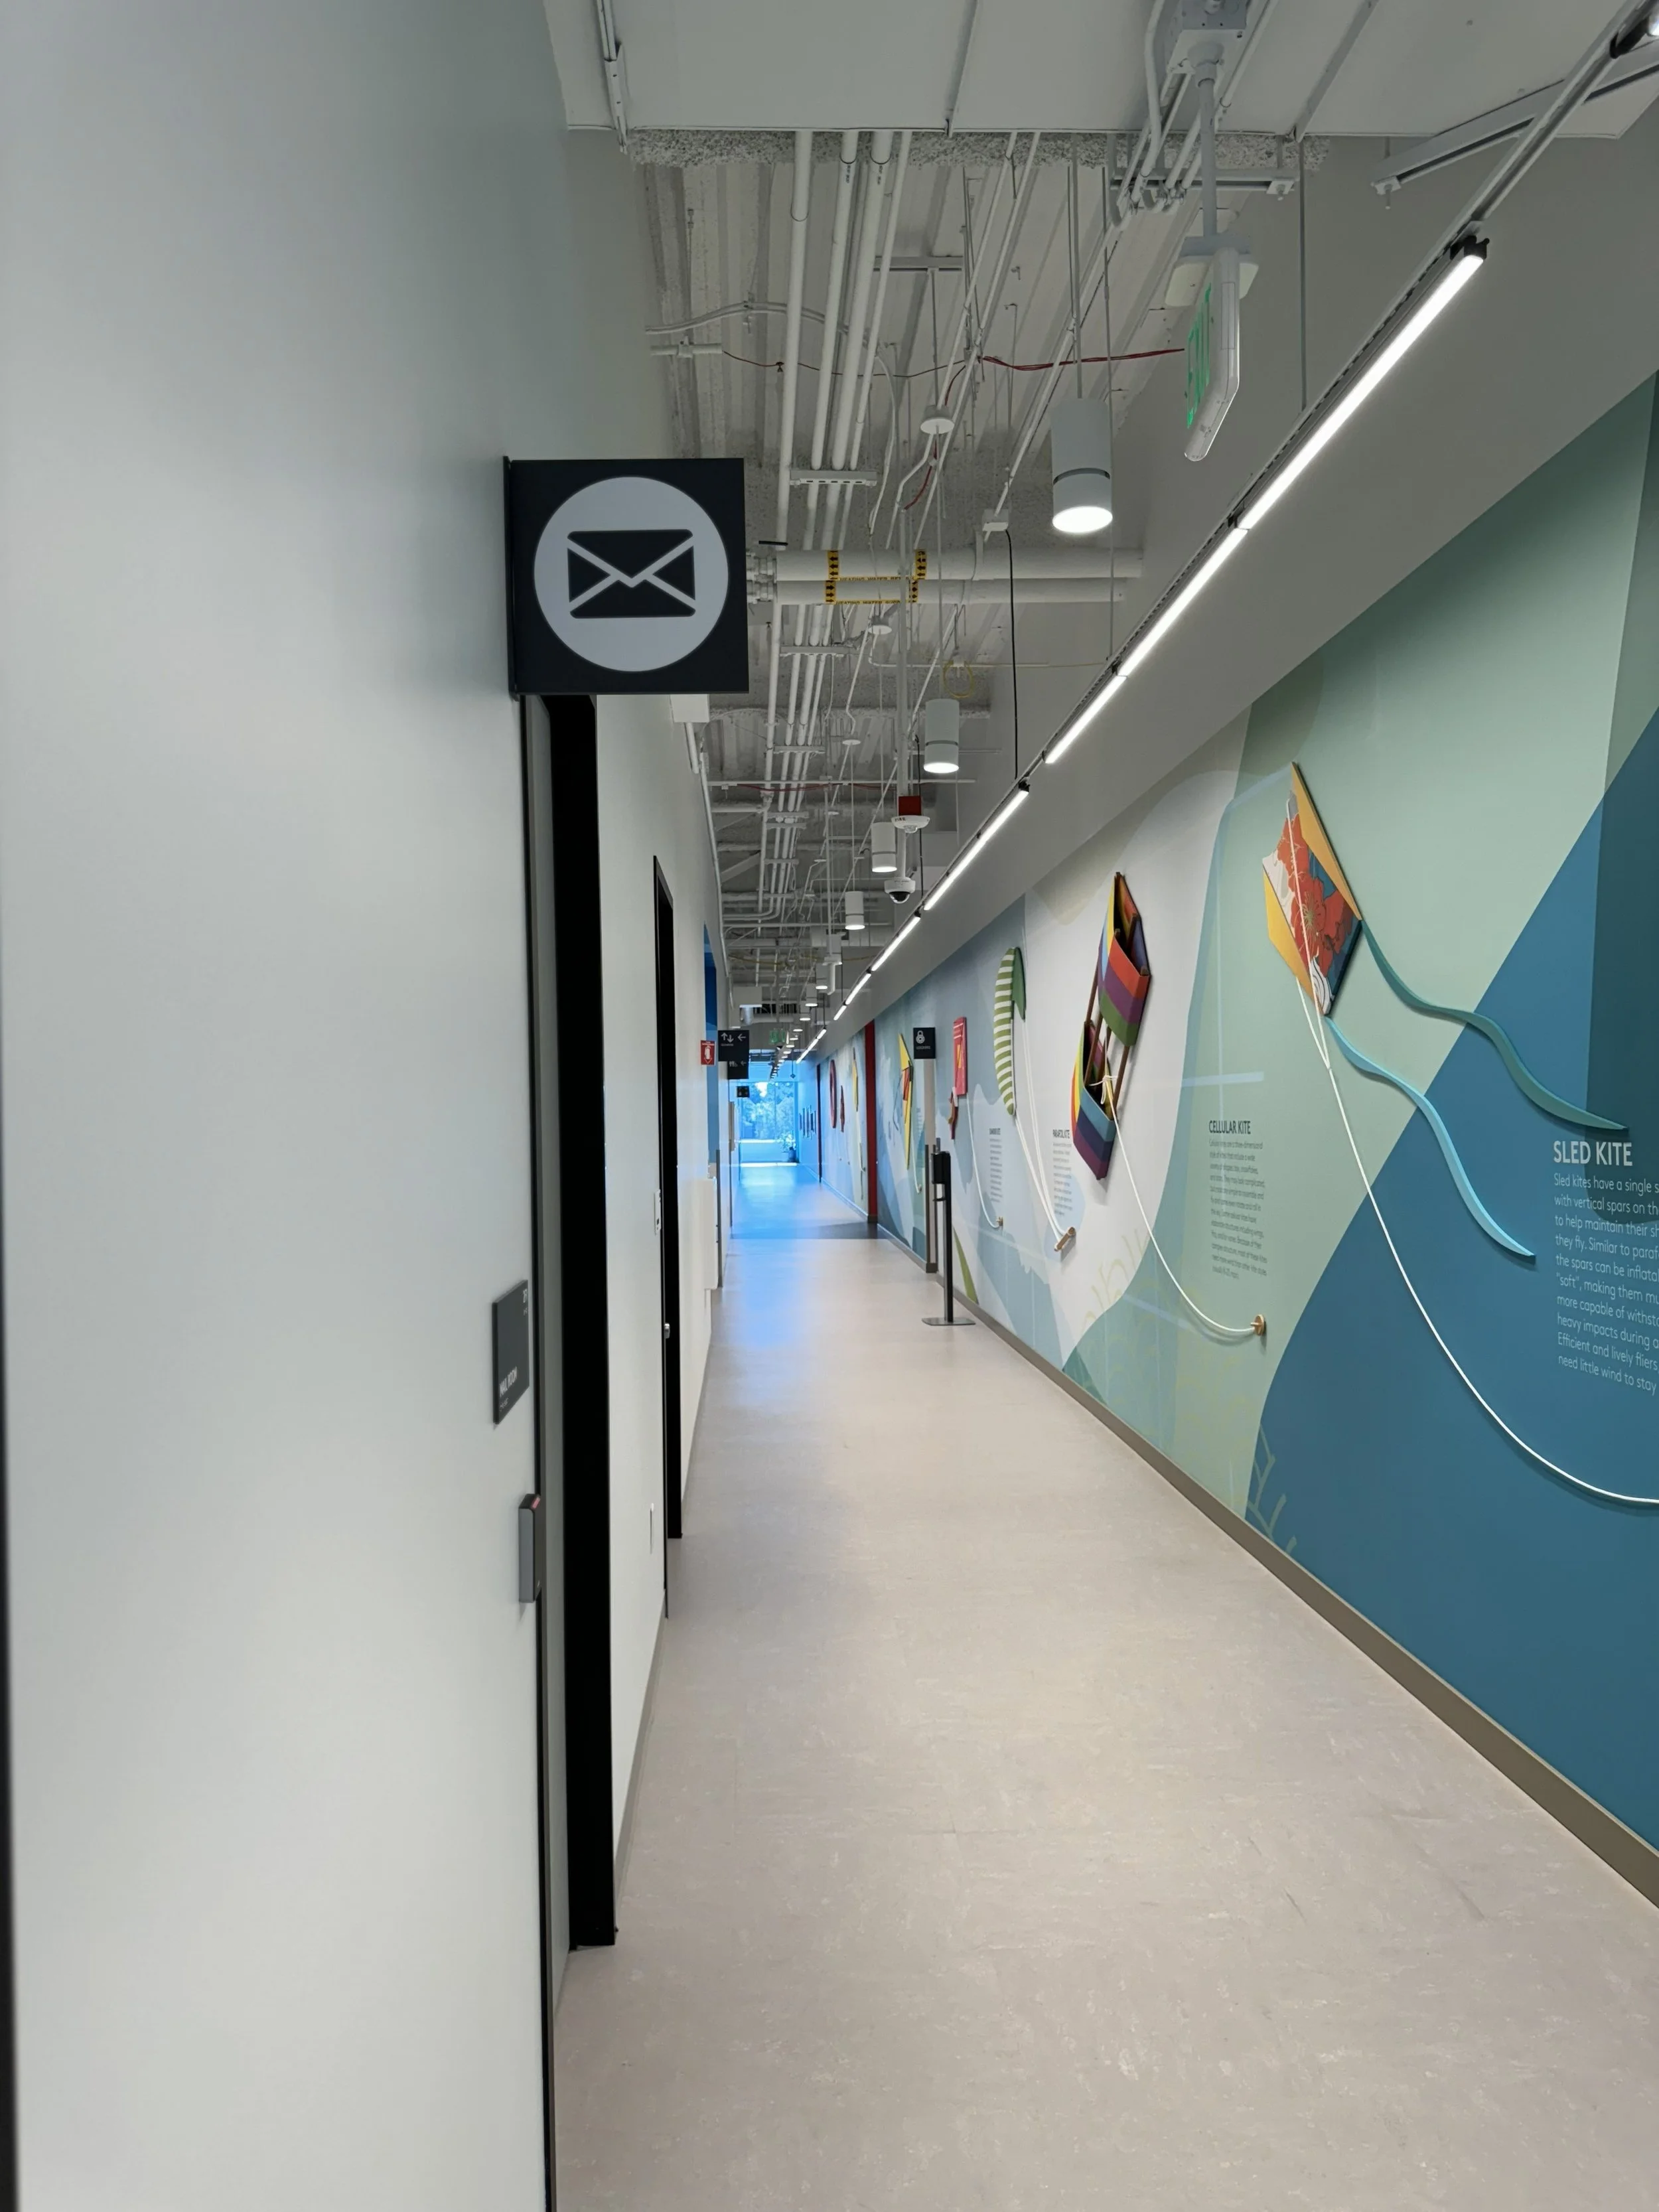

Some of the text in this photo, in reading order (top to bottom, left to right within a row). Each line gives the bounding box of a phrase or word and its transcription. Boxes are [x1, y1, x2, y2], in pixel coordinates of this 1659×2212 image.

[1209, 1120, 1251, 1134] CELLULAR KITE
[1553, 1141, 1632, 1166] SLED KITE
[1554, 1173, 1570, 1187] Sled
[1573, 1174, 1591, 1188] kites
[1593, 1175, 1614, 1190] have
[1617, 1181, 1622, 1191] a
[1625, 1179, 1652, 1197] single
[1554, 1194, 1659, 1215] with vertical spars on th
[1555, 1215, 1563, 1226] to
[1565, 1214, 1582, 1231] help
[1585, 1218, 1623, 1233] maintain
[1626, 1221, 1647, 1236] their
[1555, 1234, 1659, 1260] they fly. Similar to paraf
[1555, 1253, 1659, 1282] the spars can be inflata
[1584, 1280, 1615, 1299] making
[1618, 1284, 1642, 1301] them
[1557, 1296, 1577, 1309] more
[1580, 1301, 1613, 1316] capable
[1616, 1305, 1624, 1319] of
[1557, 1312, 1581, 1333] heavy
[1583, 1319, 1618, 1339] impacts
[1621, 1328, 1650, 1351] during
[1558, 1332, 1590, 1352] Efficient
[1593, 1345, 1609, 1357] and
[1612, 1345, 1633, 1367] lively
[1559, 1355, 1656, 1396] need little wind to stay
